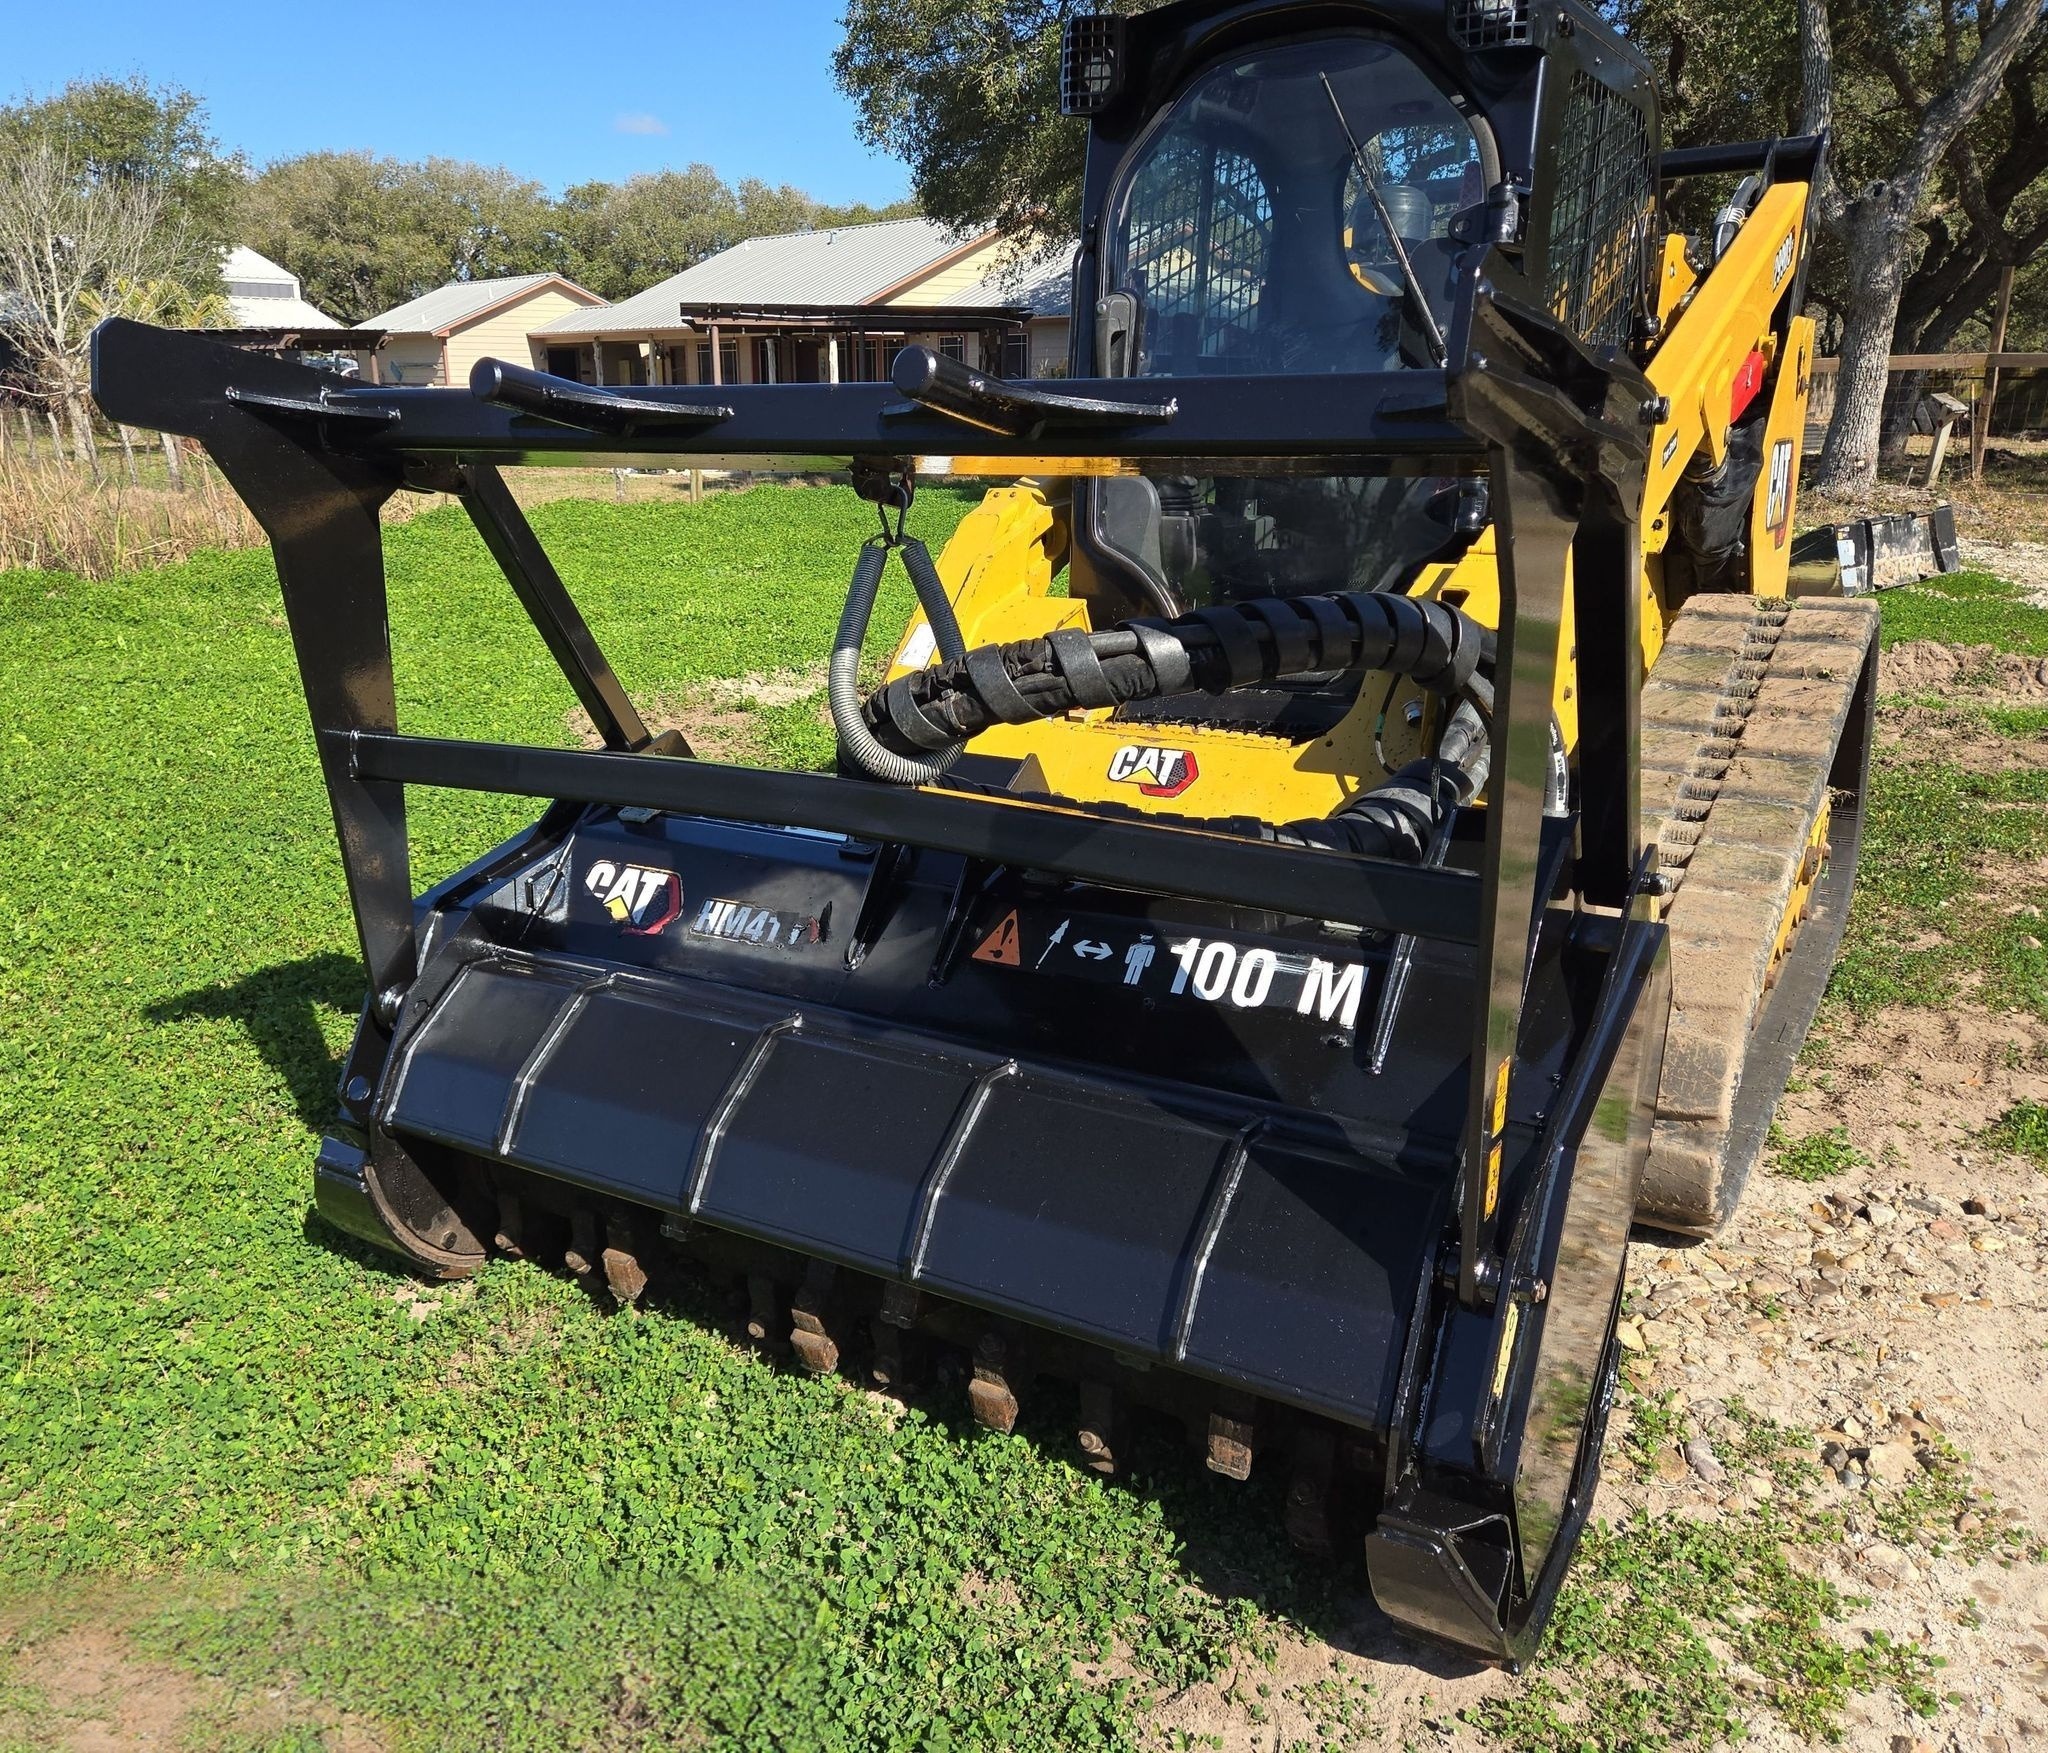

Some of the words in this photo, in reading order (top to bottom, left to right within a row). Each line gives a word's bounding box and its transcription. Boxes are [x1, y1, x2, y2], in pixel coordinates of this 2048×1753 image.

[1766, 443, 1792, 529] CAT
[1107, 745, 1185, 786] CAT
[585, 860, 669, 924] CAT
[1169, 937, 1276, 1008] 100
[1297, 957, 1369, 1030] M
